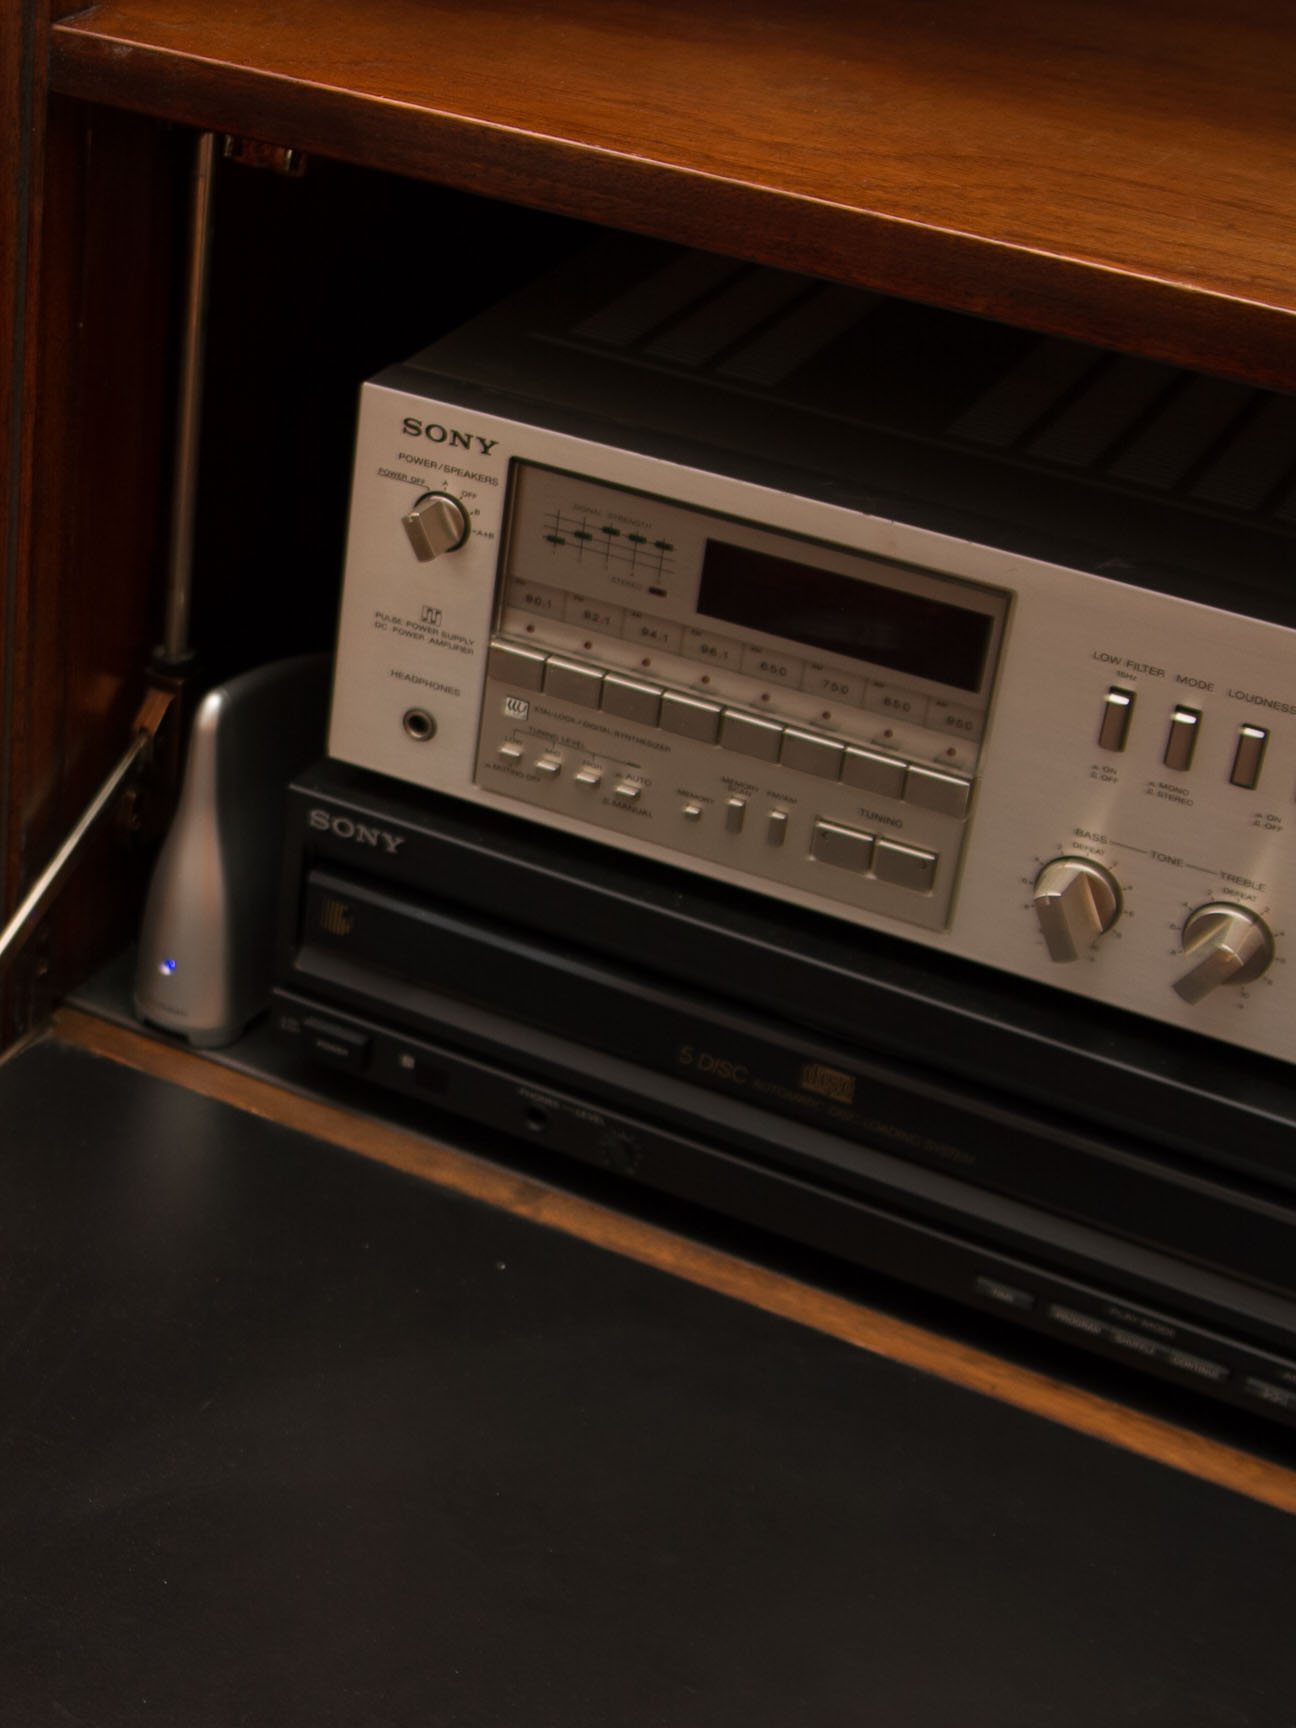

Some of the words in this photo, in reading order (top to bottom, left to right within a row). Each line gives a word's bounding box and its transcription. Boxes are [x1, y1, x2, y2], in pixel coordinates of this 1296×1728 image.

[402, 417, 499, 456] SONY
[378, 466, 409, 481] POWER
[398, 452, 499, 487] POWER/SPEAKERS
[392, 626, 424, 640] POWER
[429, 637, 474, 655] AMPLIFIER
[406, 621, 439, 636] POWER
[441, 631, 475, 646] SUPPLY
[1092, 651, 1123, 667] LOW
[1125, 659, 1165, 679] FILTER
[390, 669, 461, 697] HEADPHONES
[823, 679, 849, 695] 750
[1176, 674, 1215, 692] MODE
[1228, 689, 1296, 715] LOUDNESS
[625, 773, 651, 786] AUTO
[1100, 774, 1119, 784] OFF
[1158, 782, 1190, 797] MONO
[612, 799, 653, 818] MANUAL
[1157, 792, 1194, 807] STEREO
[860, 808, 904, 829] TUNING
[1264, 822, 1283, 832] OFF
[1266, 813, 1282, 823] ON
[309, 808, 406, 854] SONY
[1074, 828, 1109, 845] BASS
[1150, 851, 1184, 867] TONE
[1221, 871, 1266, 892] TREBLE
[679, 1045, 694, 1066] 5
[697, 1051, 749, 1084] DISC
